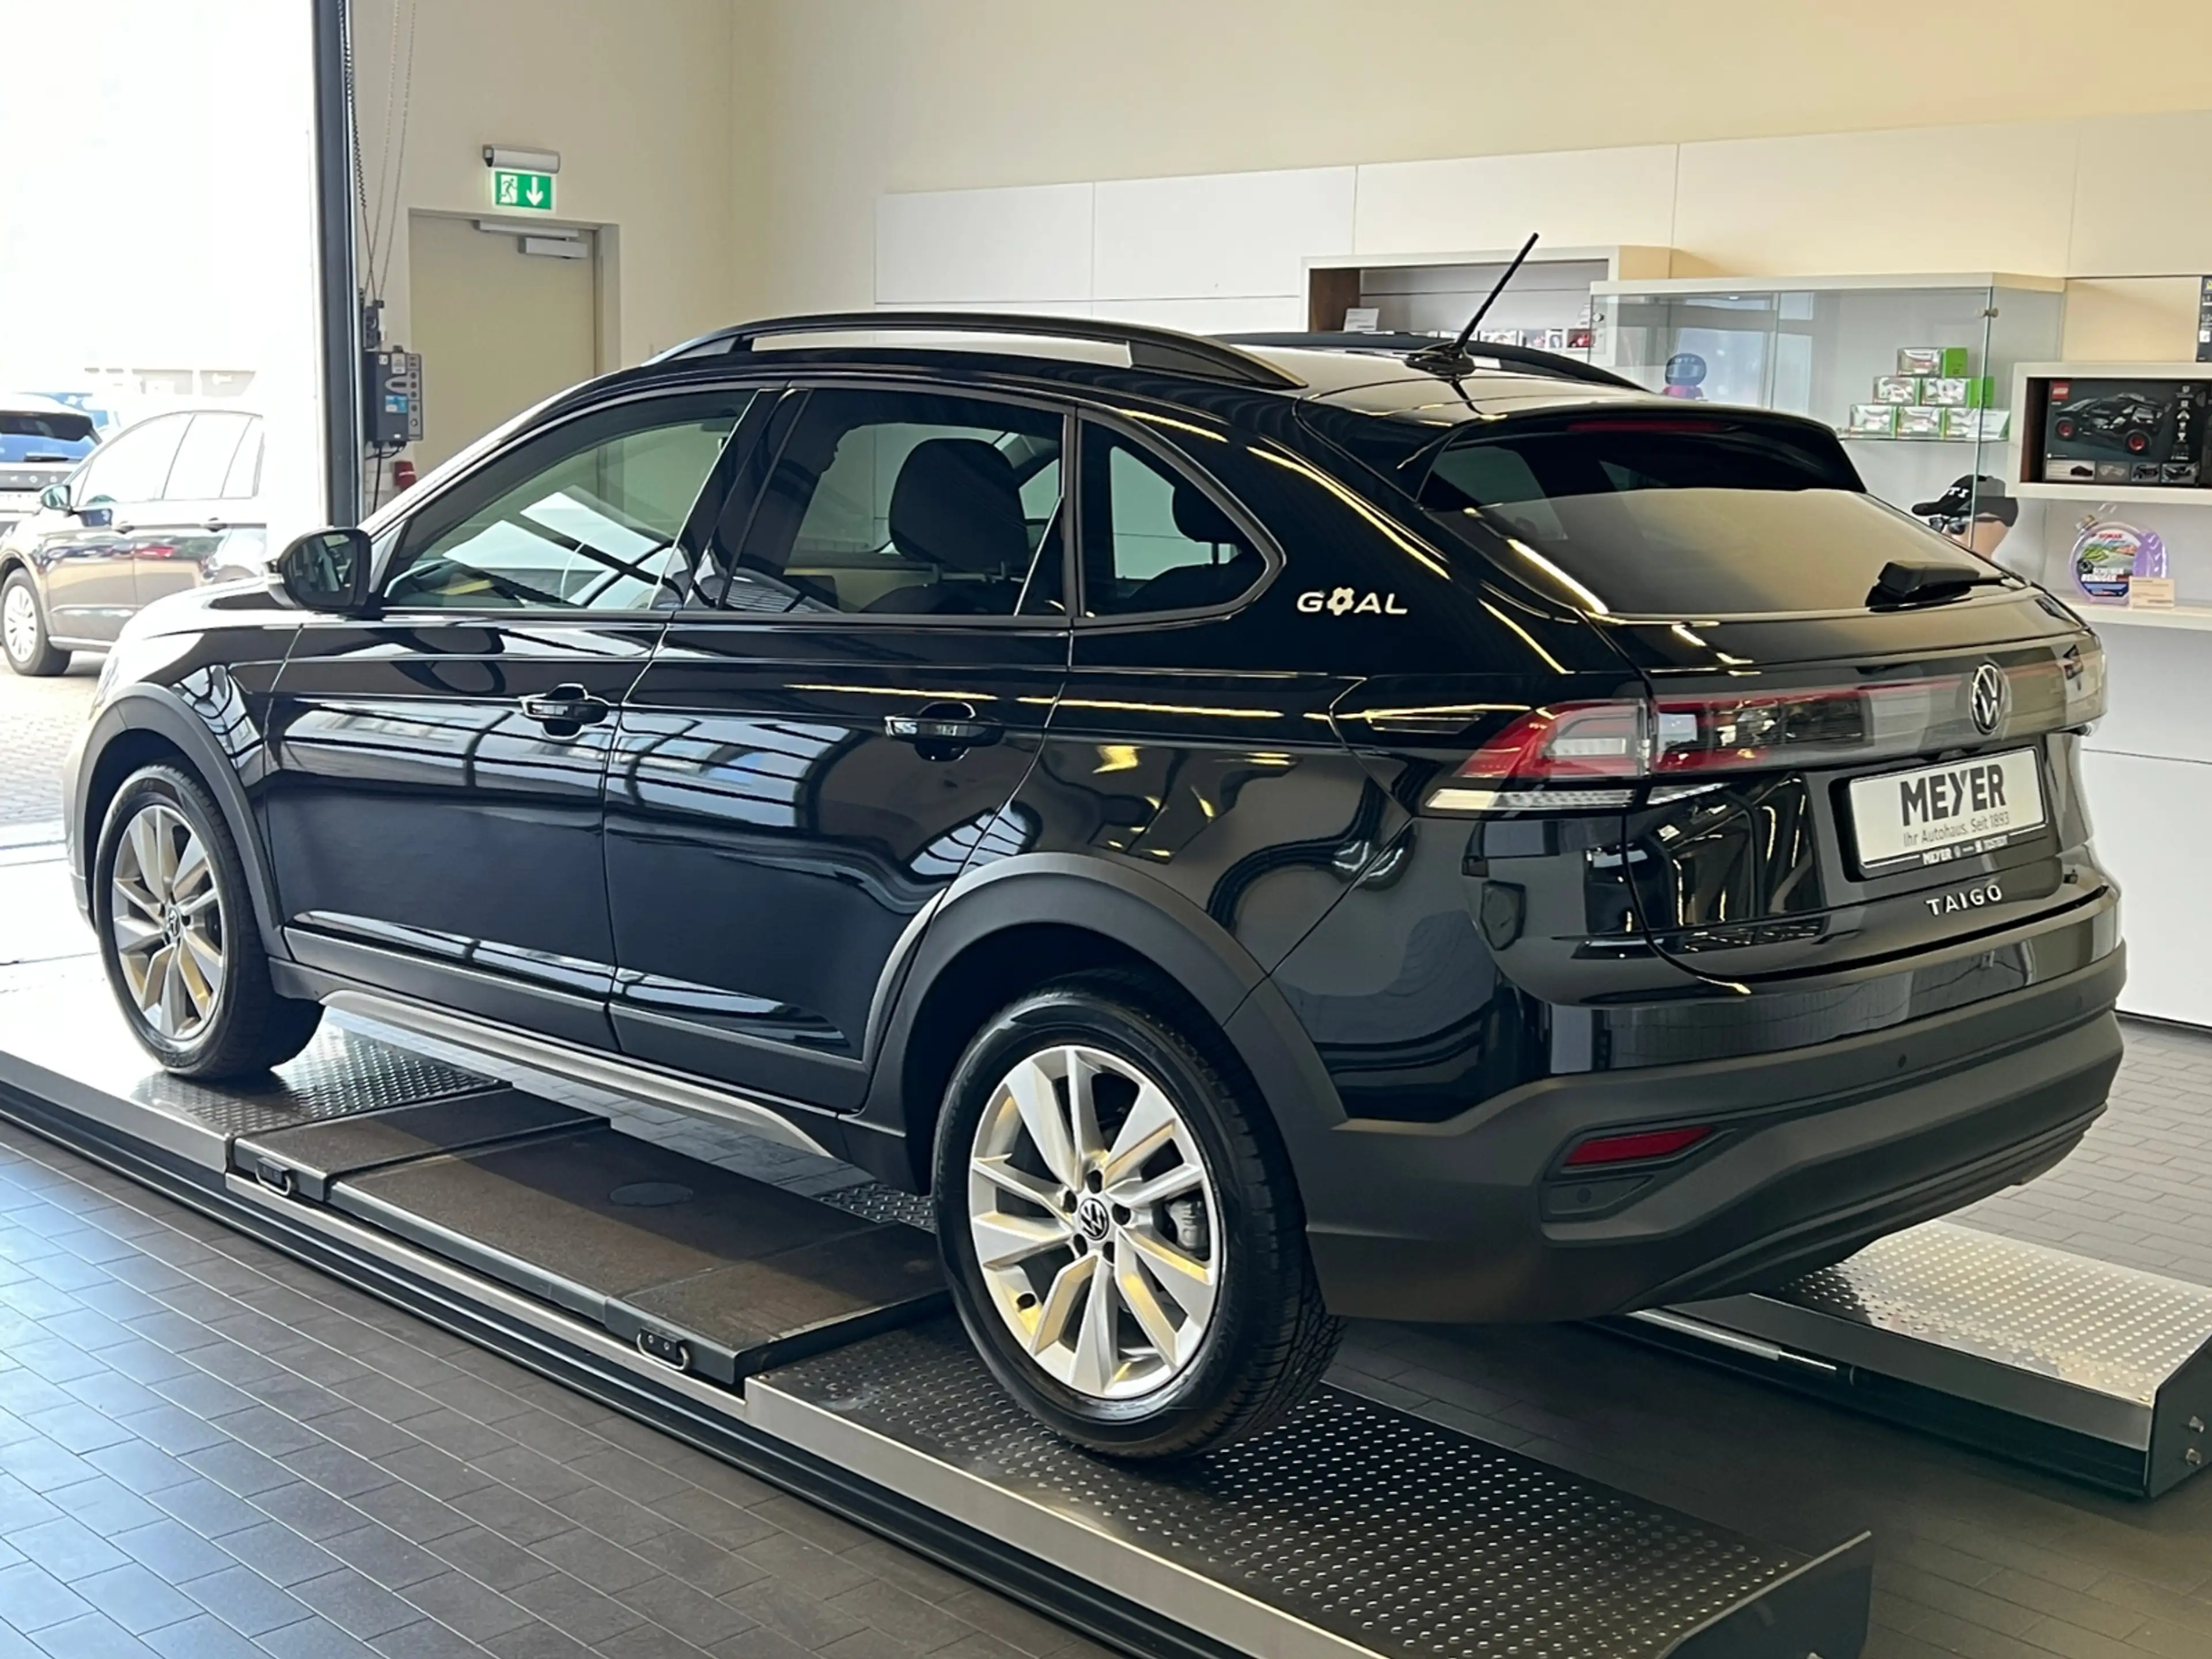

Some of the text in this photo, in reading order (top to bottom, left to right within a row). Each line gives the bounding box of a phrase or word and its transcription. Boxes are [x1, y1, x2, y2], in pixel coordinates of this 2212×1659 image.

[1900, 764, 2006, 827] MEYER
[1904, 831, 1918, 847] Ihr
[1971, 816, 1988, 833] Seit
[1926, 884, 2002, 915] TAIGO
